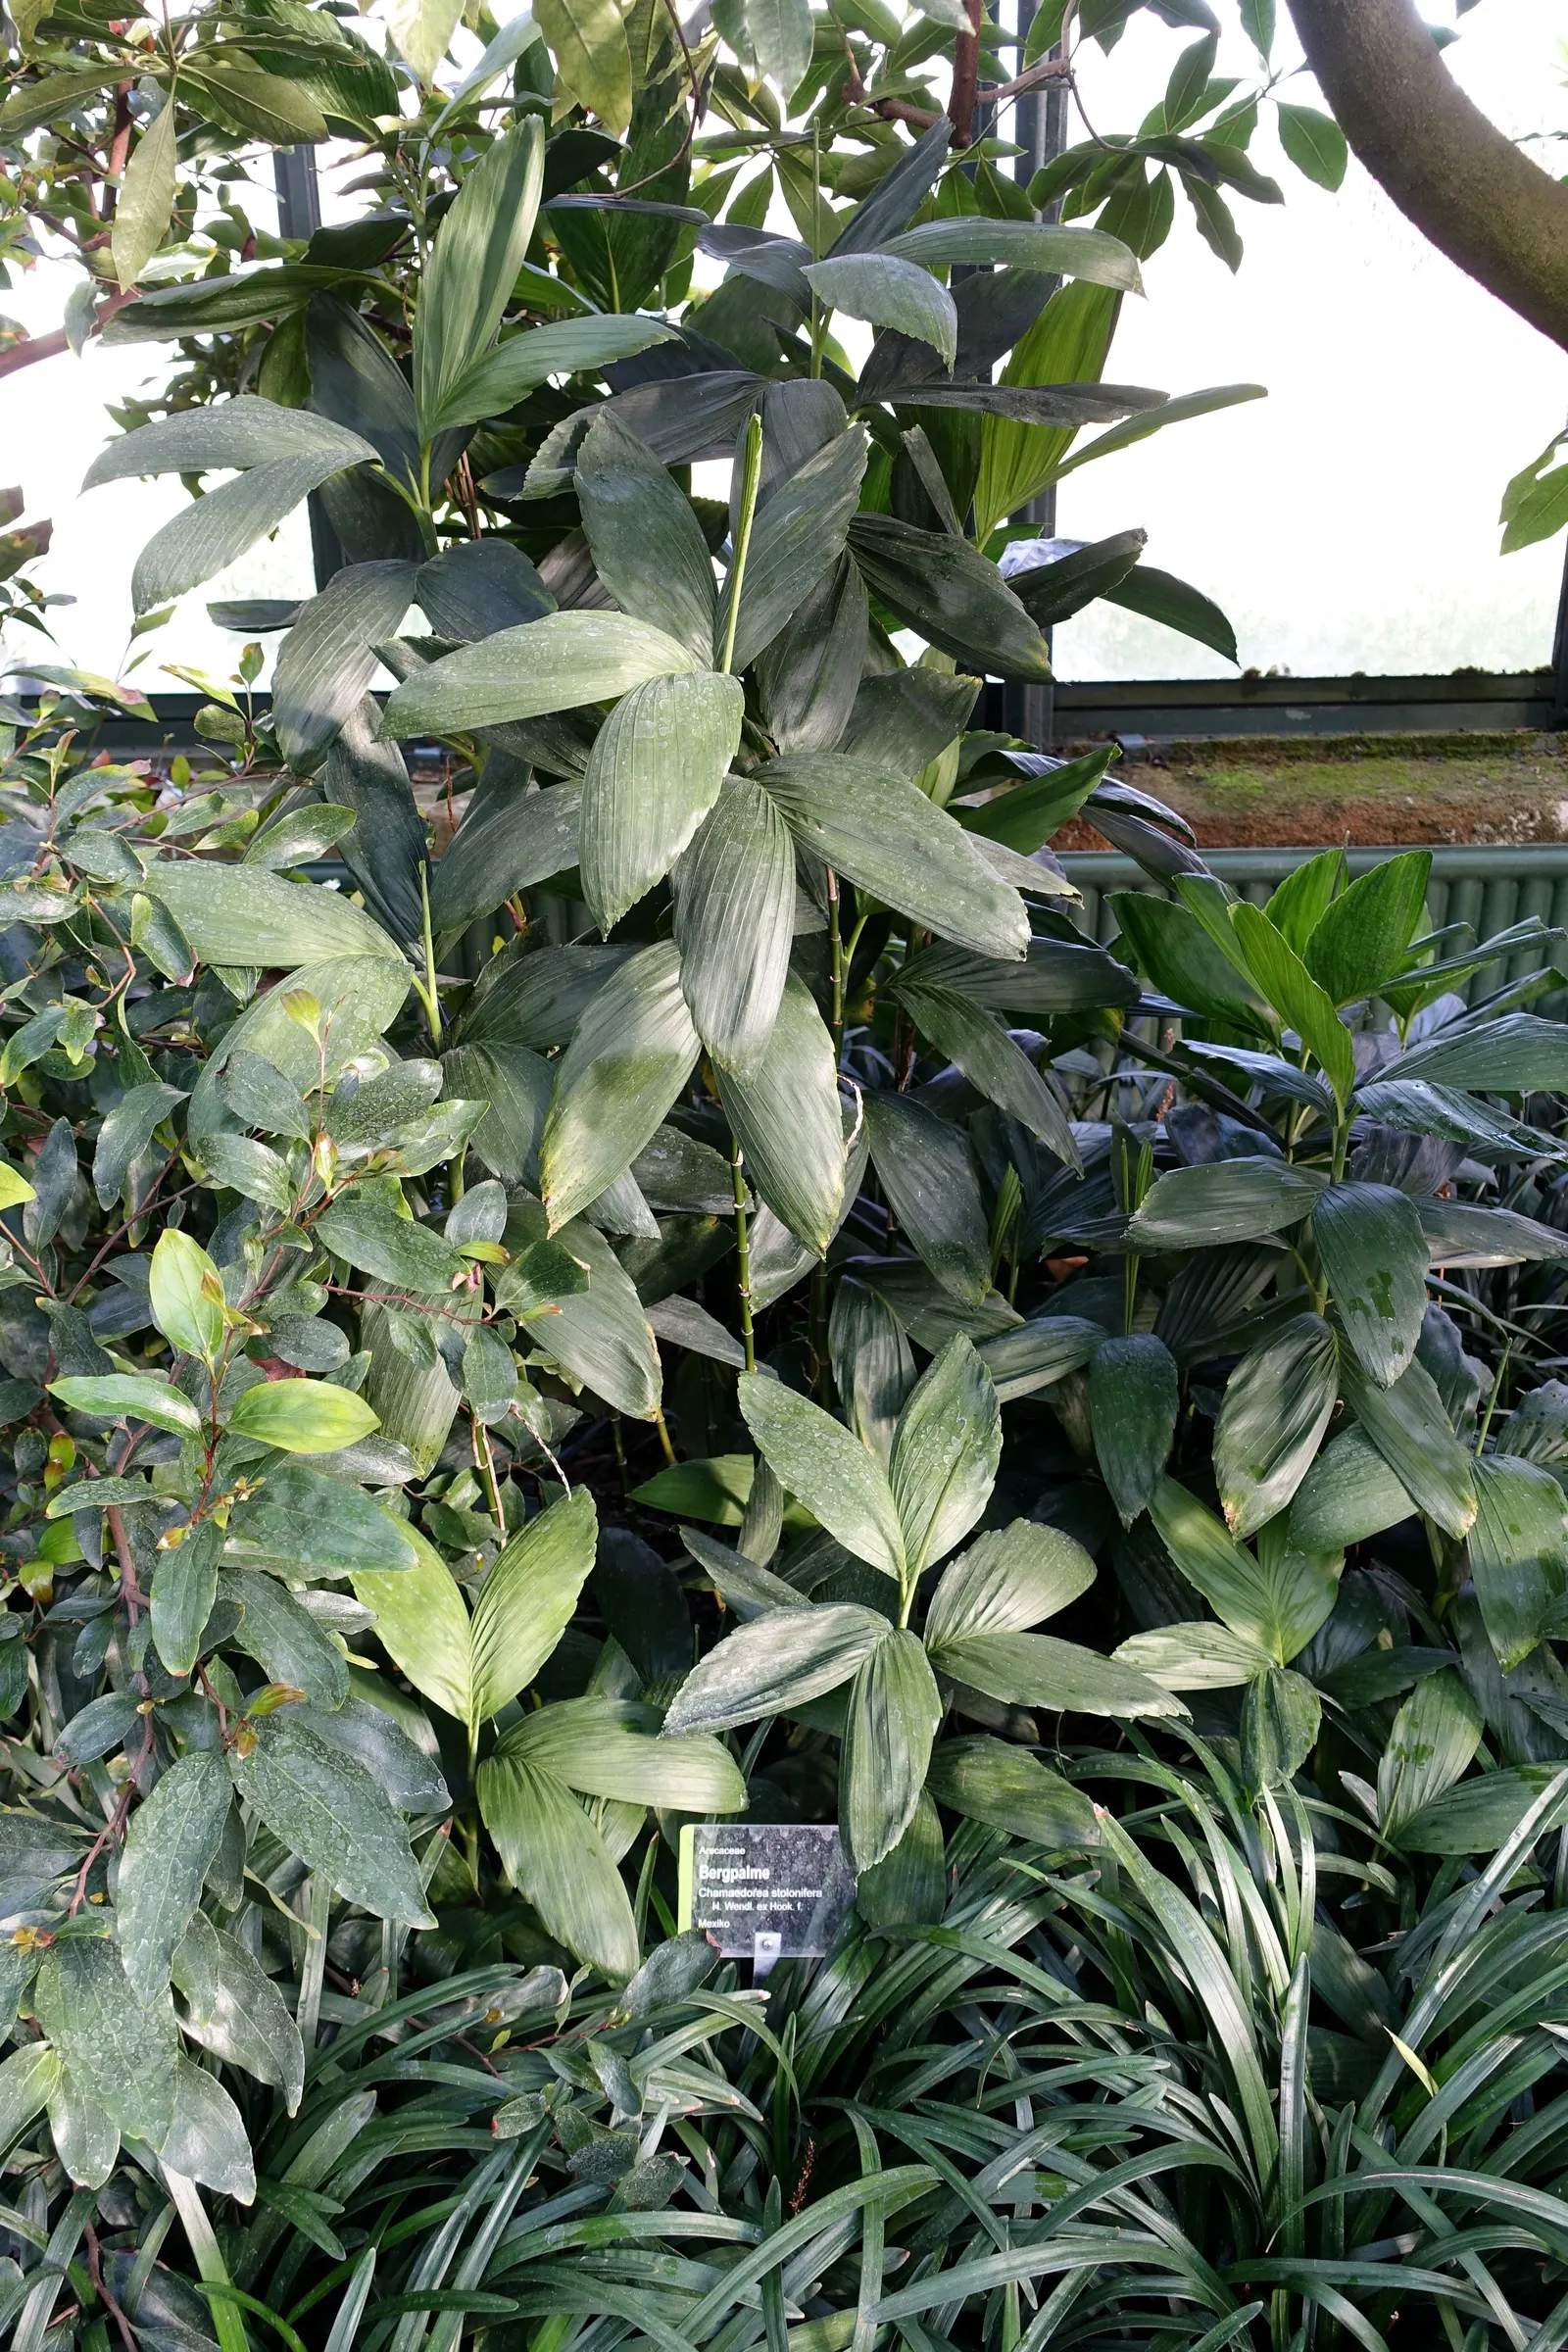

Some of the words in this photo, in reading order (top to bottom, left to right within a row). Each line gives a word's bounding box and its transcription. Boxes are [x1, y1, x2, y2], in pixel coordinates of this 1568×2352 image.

[699, 1846, 746, 1855] Arecaceae
[699, 1865, 770, 1883] Bergpalme
[698, 1887, 768, 1898] Chamaedorea
[771, 1887, 822, 1898] stolonifera
[712, 1902, 722, 1911] H.
[724, 1902, 755, 1911] Wendl.
[769, 1902, 795, 1911] Hook.
[698, 1919, 730, 1929] Mexiko
